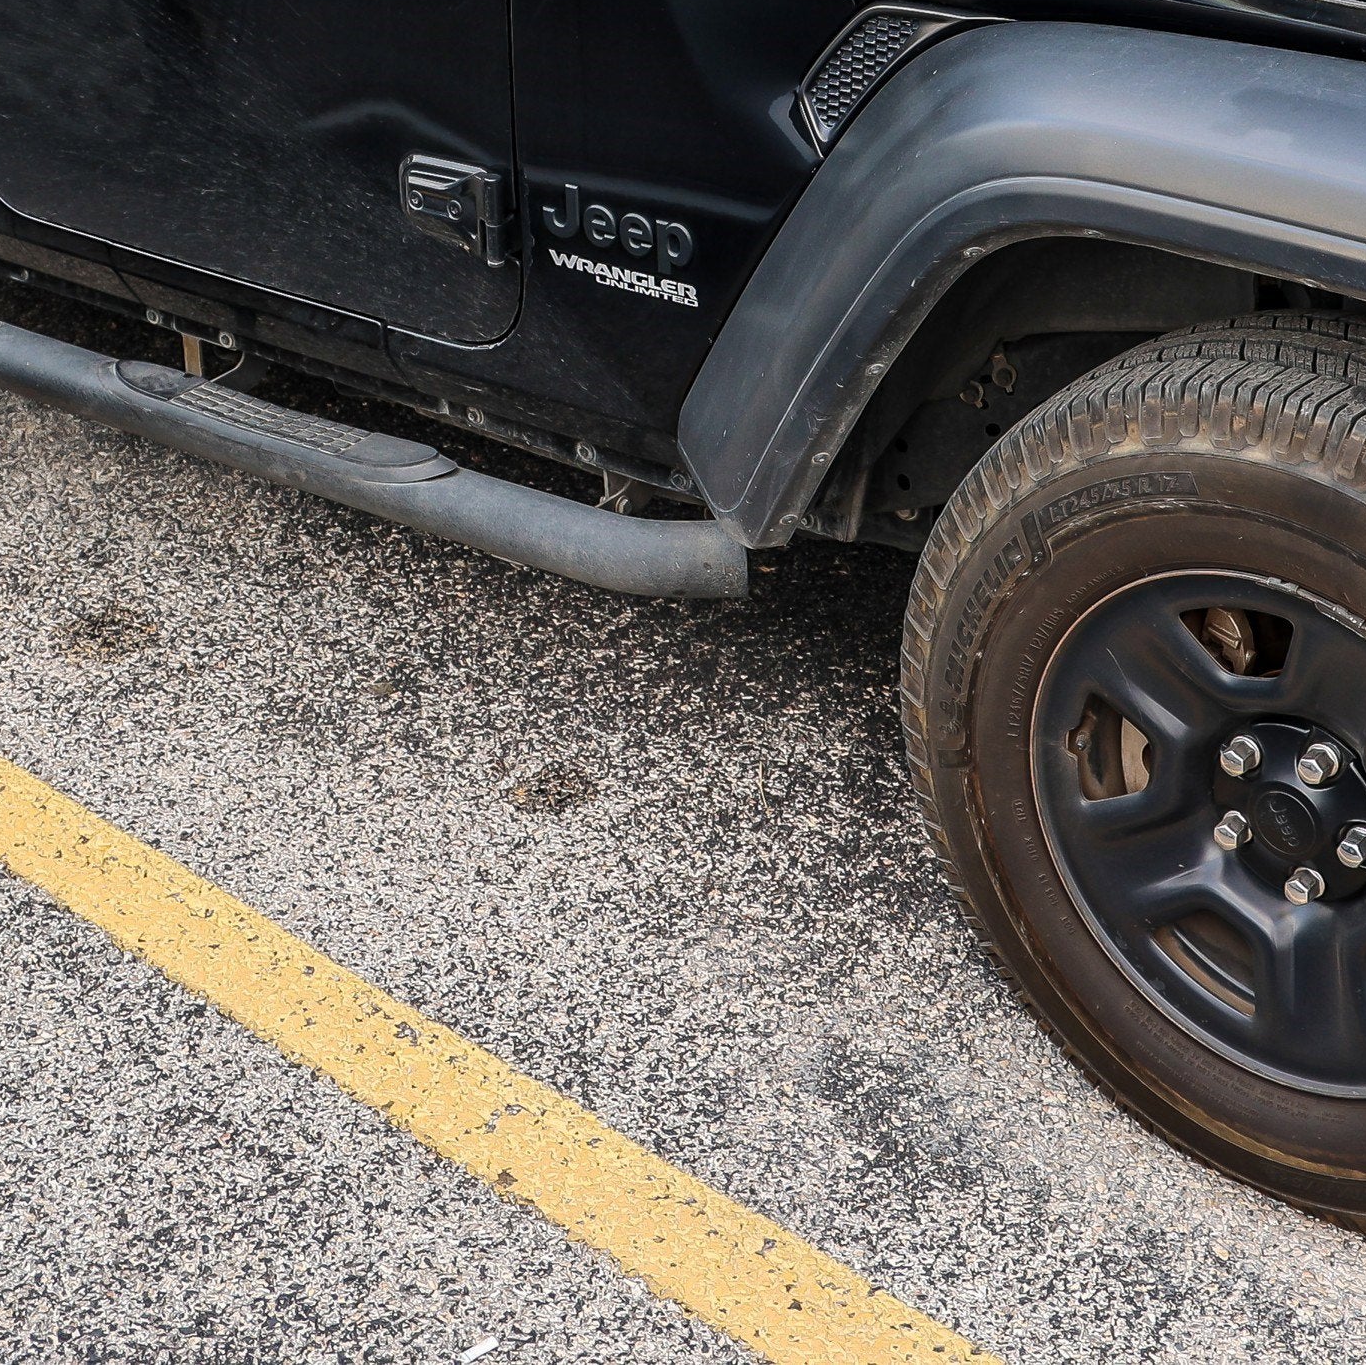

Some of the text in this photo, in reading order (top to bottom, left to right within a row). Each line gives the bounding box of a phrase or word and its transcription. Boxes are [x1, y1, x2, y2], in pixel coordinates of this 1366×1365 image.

[542, 184, 693, 274] Jeep
[548, 248, 698, 301] WRANGLER
[595, 275, 699, 307] UNLIMITED
[944, 535, 1025, 692] MICHELIN
